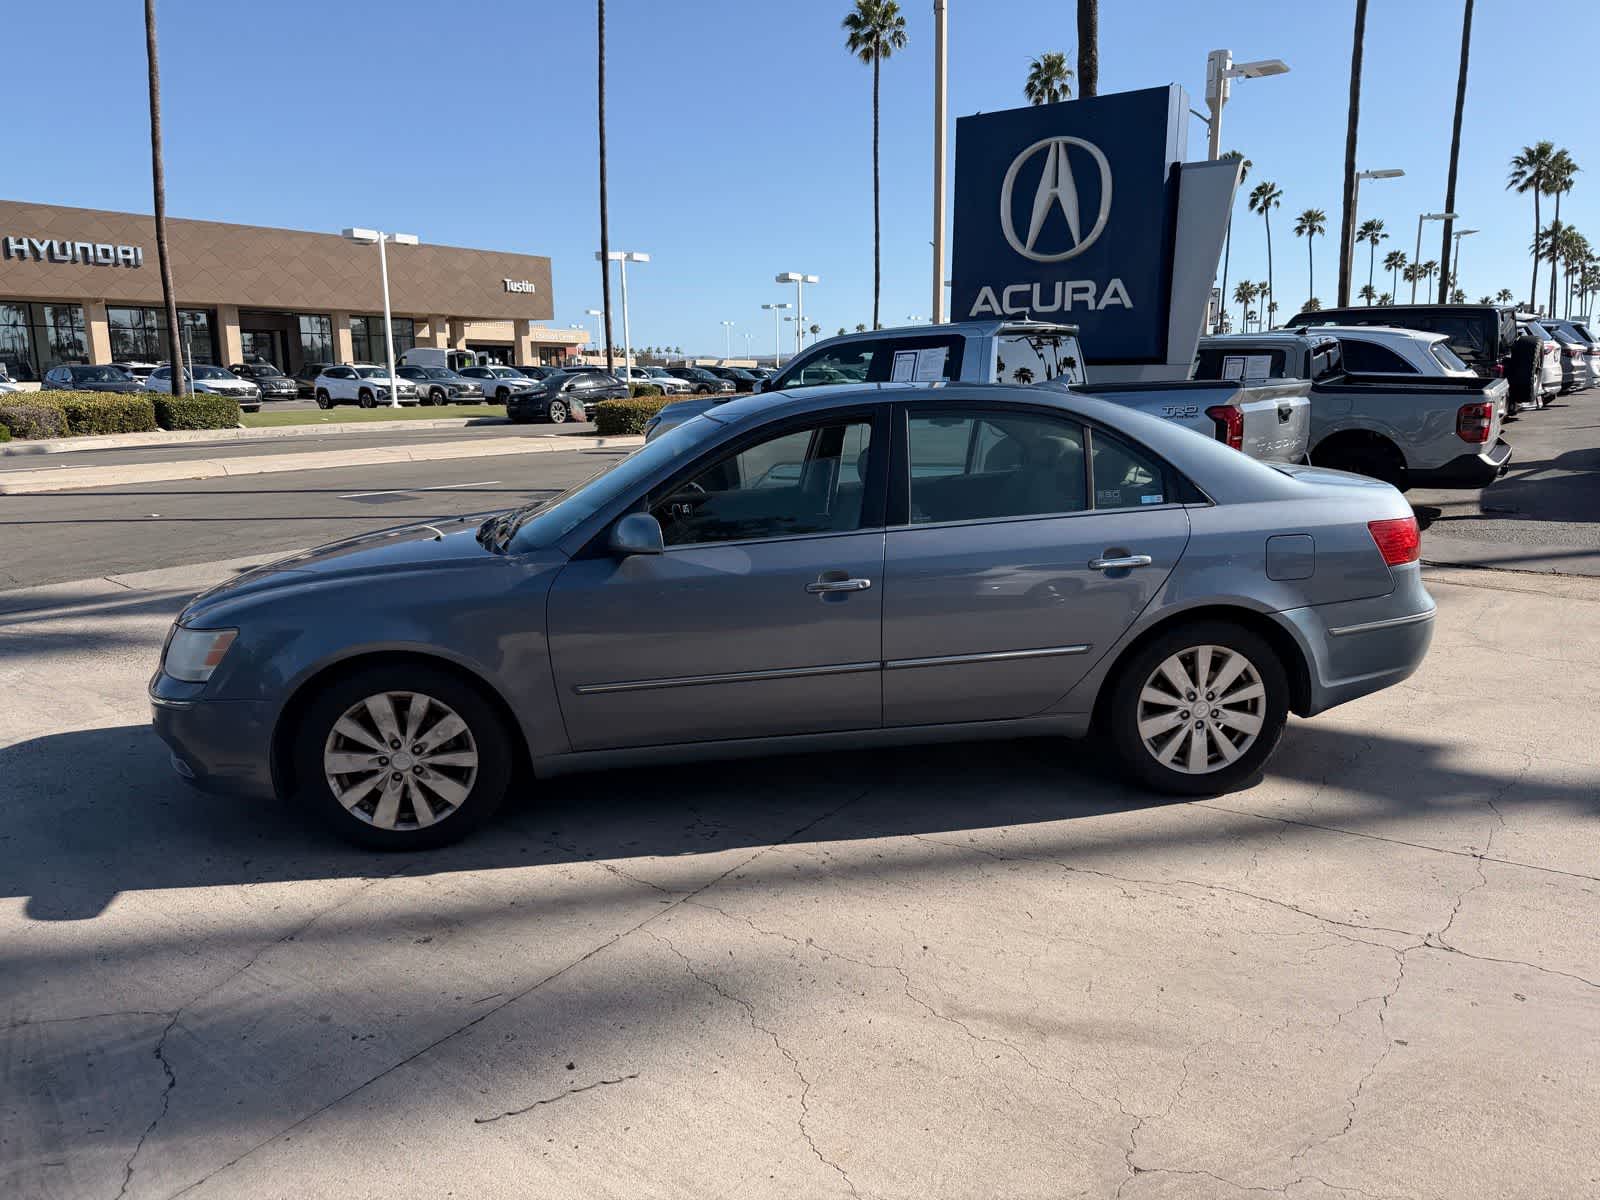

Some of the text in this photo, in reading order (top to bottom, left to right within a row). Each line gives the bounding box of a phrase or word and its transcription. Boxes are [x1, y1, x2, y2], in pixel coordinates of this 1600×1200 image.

[6, 236, 143, 267] HYUNDAI
[503, 279, 535, 293] Tustin
[968, 278, 1134, 317] ACURA
